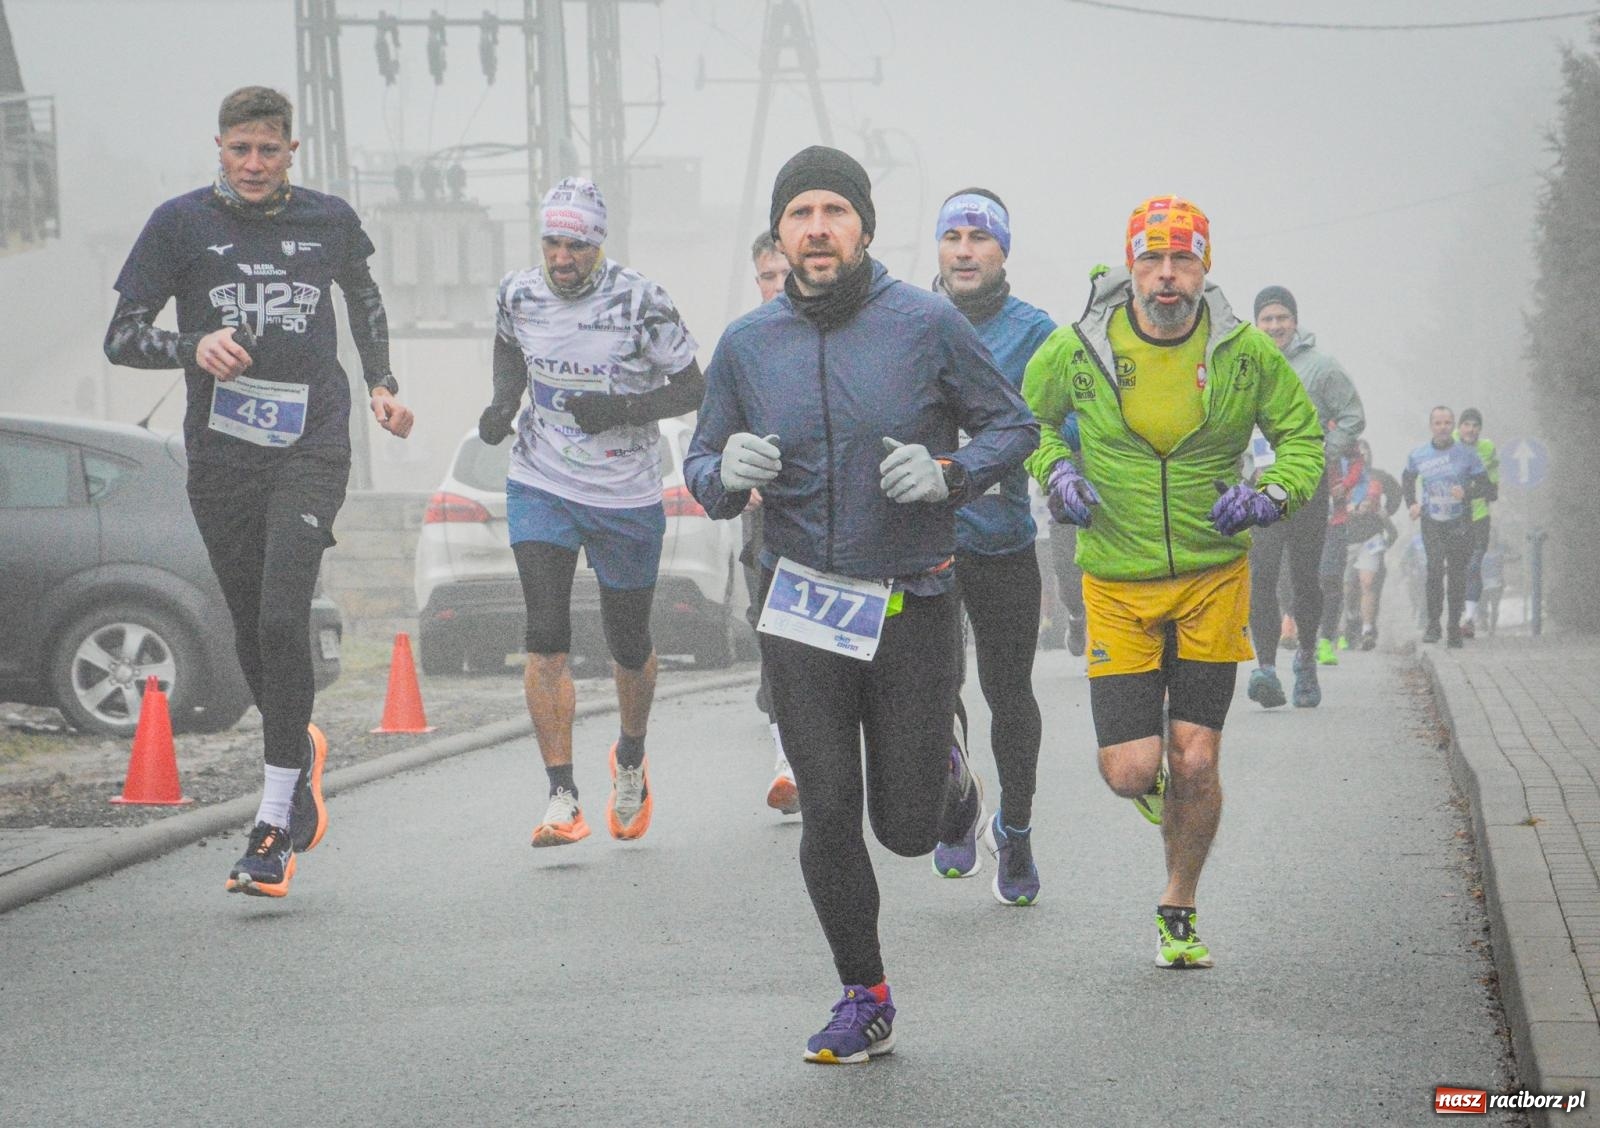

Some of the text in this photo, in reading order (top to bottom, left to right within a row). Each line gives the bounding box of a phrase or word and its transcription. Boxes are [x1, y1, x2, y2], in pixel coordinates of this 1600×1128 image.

[281, 315, 307, 333] 50
[236, 399, 280, 429] 43
[789, 580, 867, 628] 177
